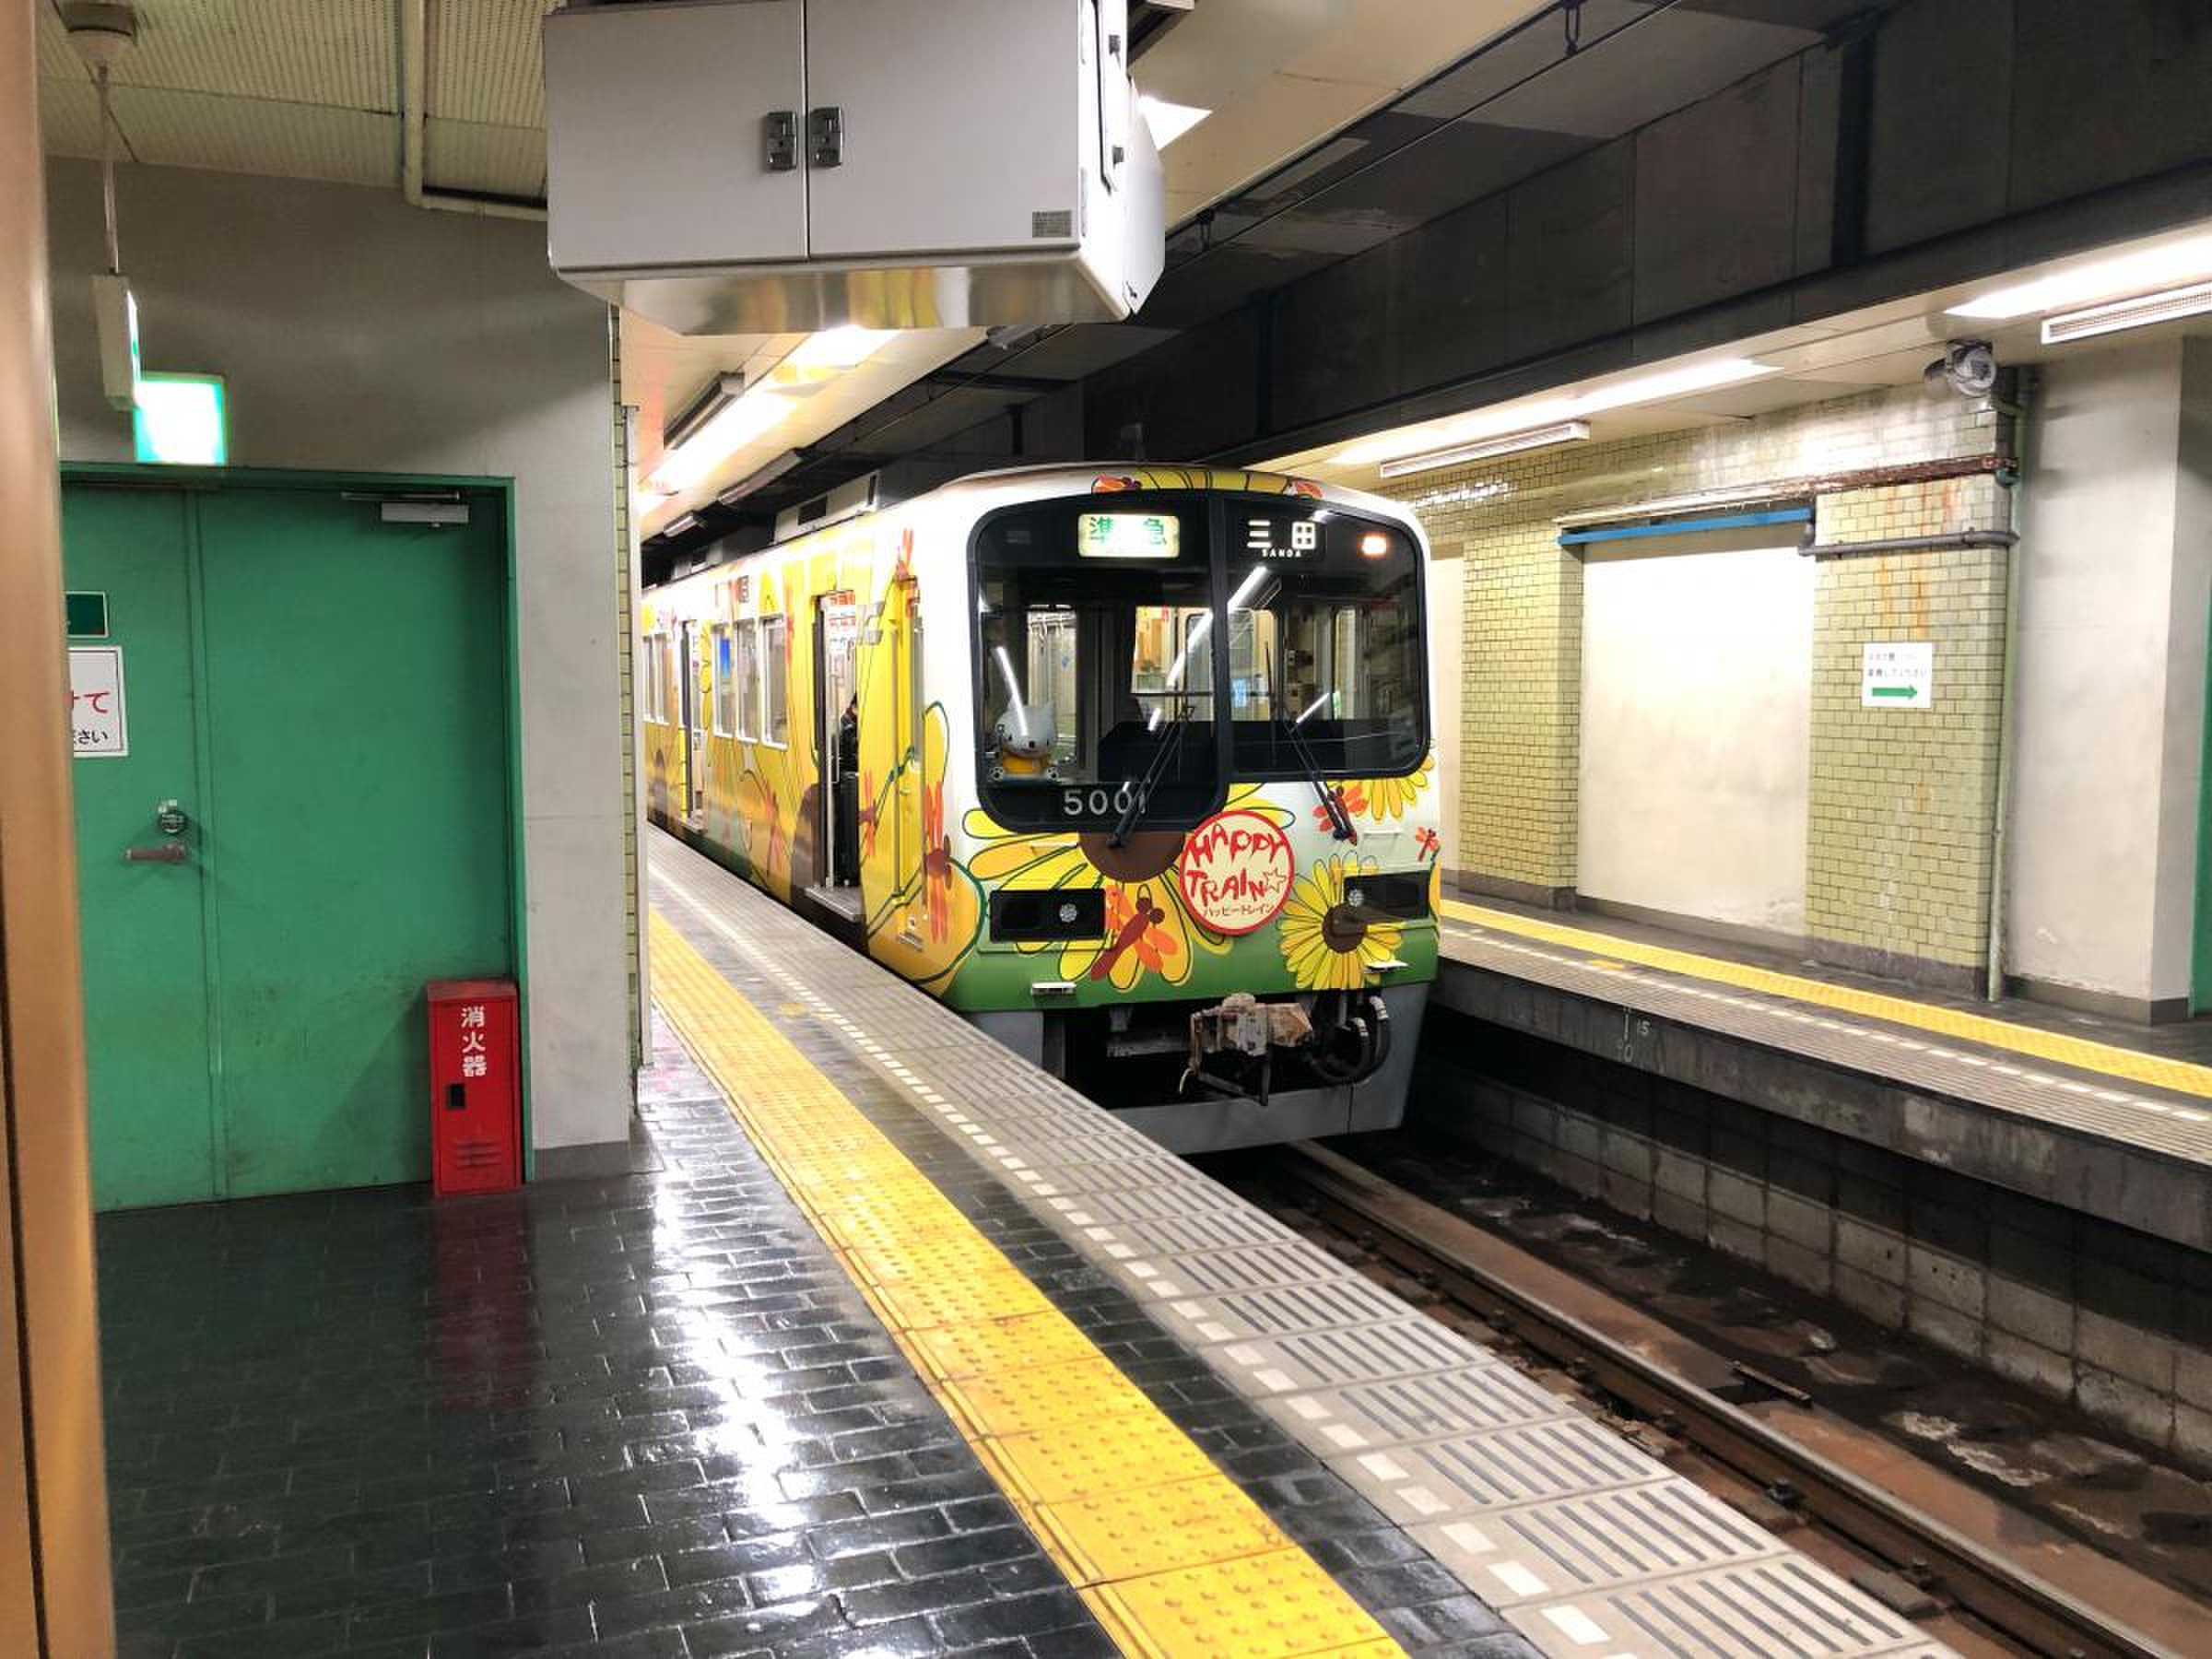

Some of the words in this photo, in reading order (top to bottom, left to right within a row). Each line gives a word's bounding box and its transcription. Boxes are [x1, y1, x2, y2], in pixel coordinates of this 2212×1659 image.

[1089, 516, 1167, 546] 準急
[1247, 520, 1315, 549] 三田
[73, 729, 109, 745] さい
[1064, 789, 1146, 816] 5001
[1186, 823, 1286, 867] HAPPY
[461, 1005, 488, 1077] 消火器
